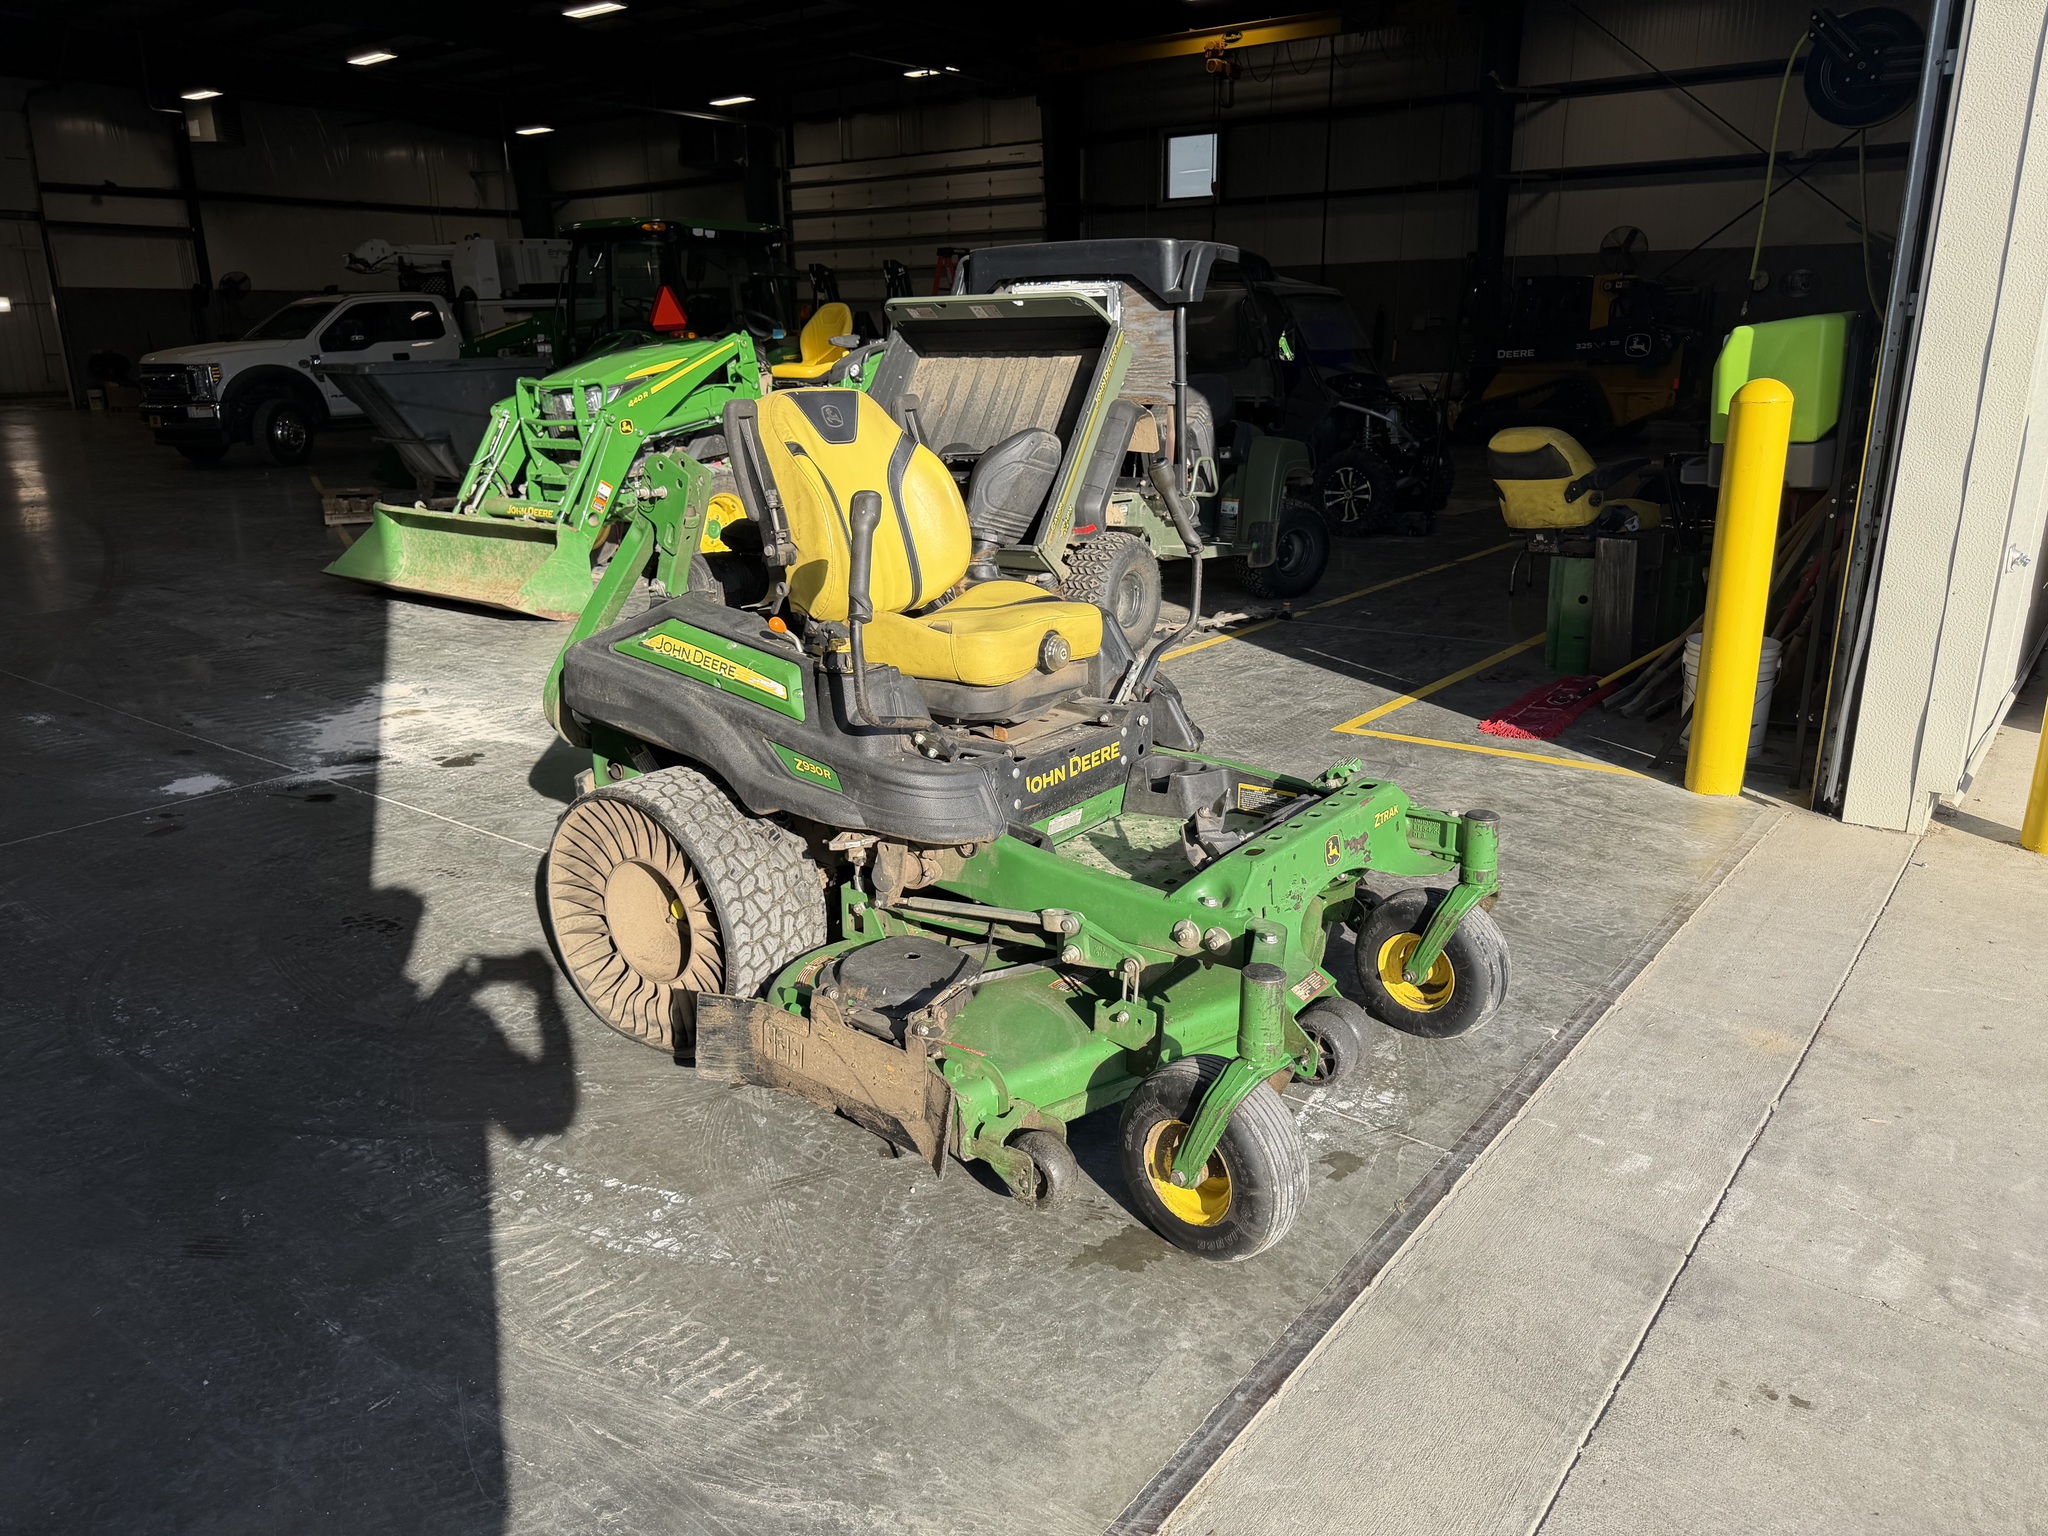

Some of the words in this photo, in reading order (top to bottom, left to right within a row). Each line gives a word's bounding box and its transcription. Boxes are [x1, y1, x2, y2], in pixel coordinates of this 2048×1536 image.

[1497, 349, 1535, 359] DEERE
[528, 506, 554, 519] DEERE
[655, 637, 691, 661] JOHN
[693, 649, 737, 678] DEERE
[793, 757, 832, 780] Z930R
[1069, 741, 1121, 777] DEERE
[1374, 804, 1399, 828] ZTRAK
